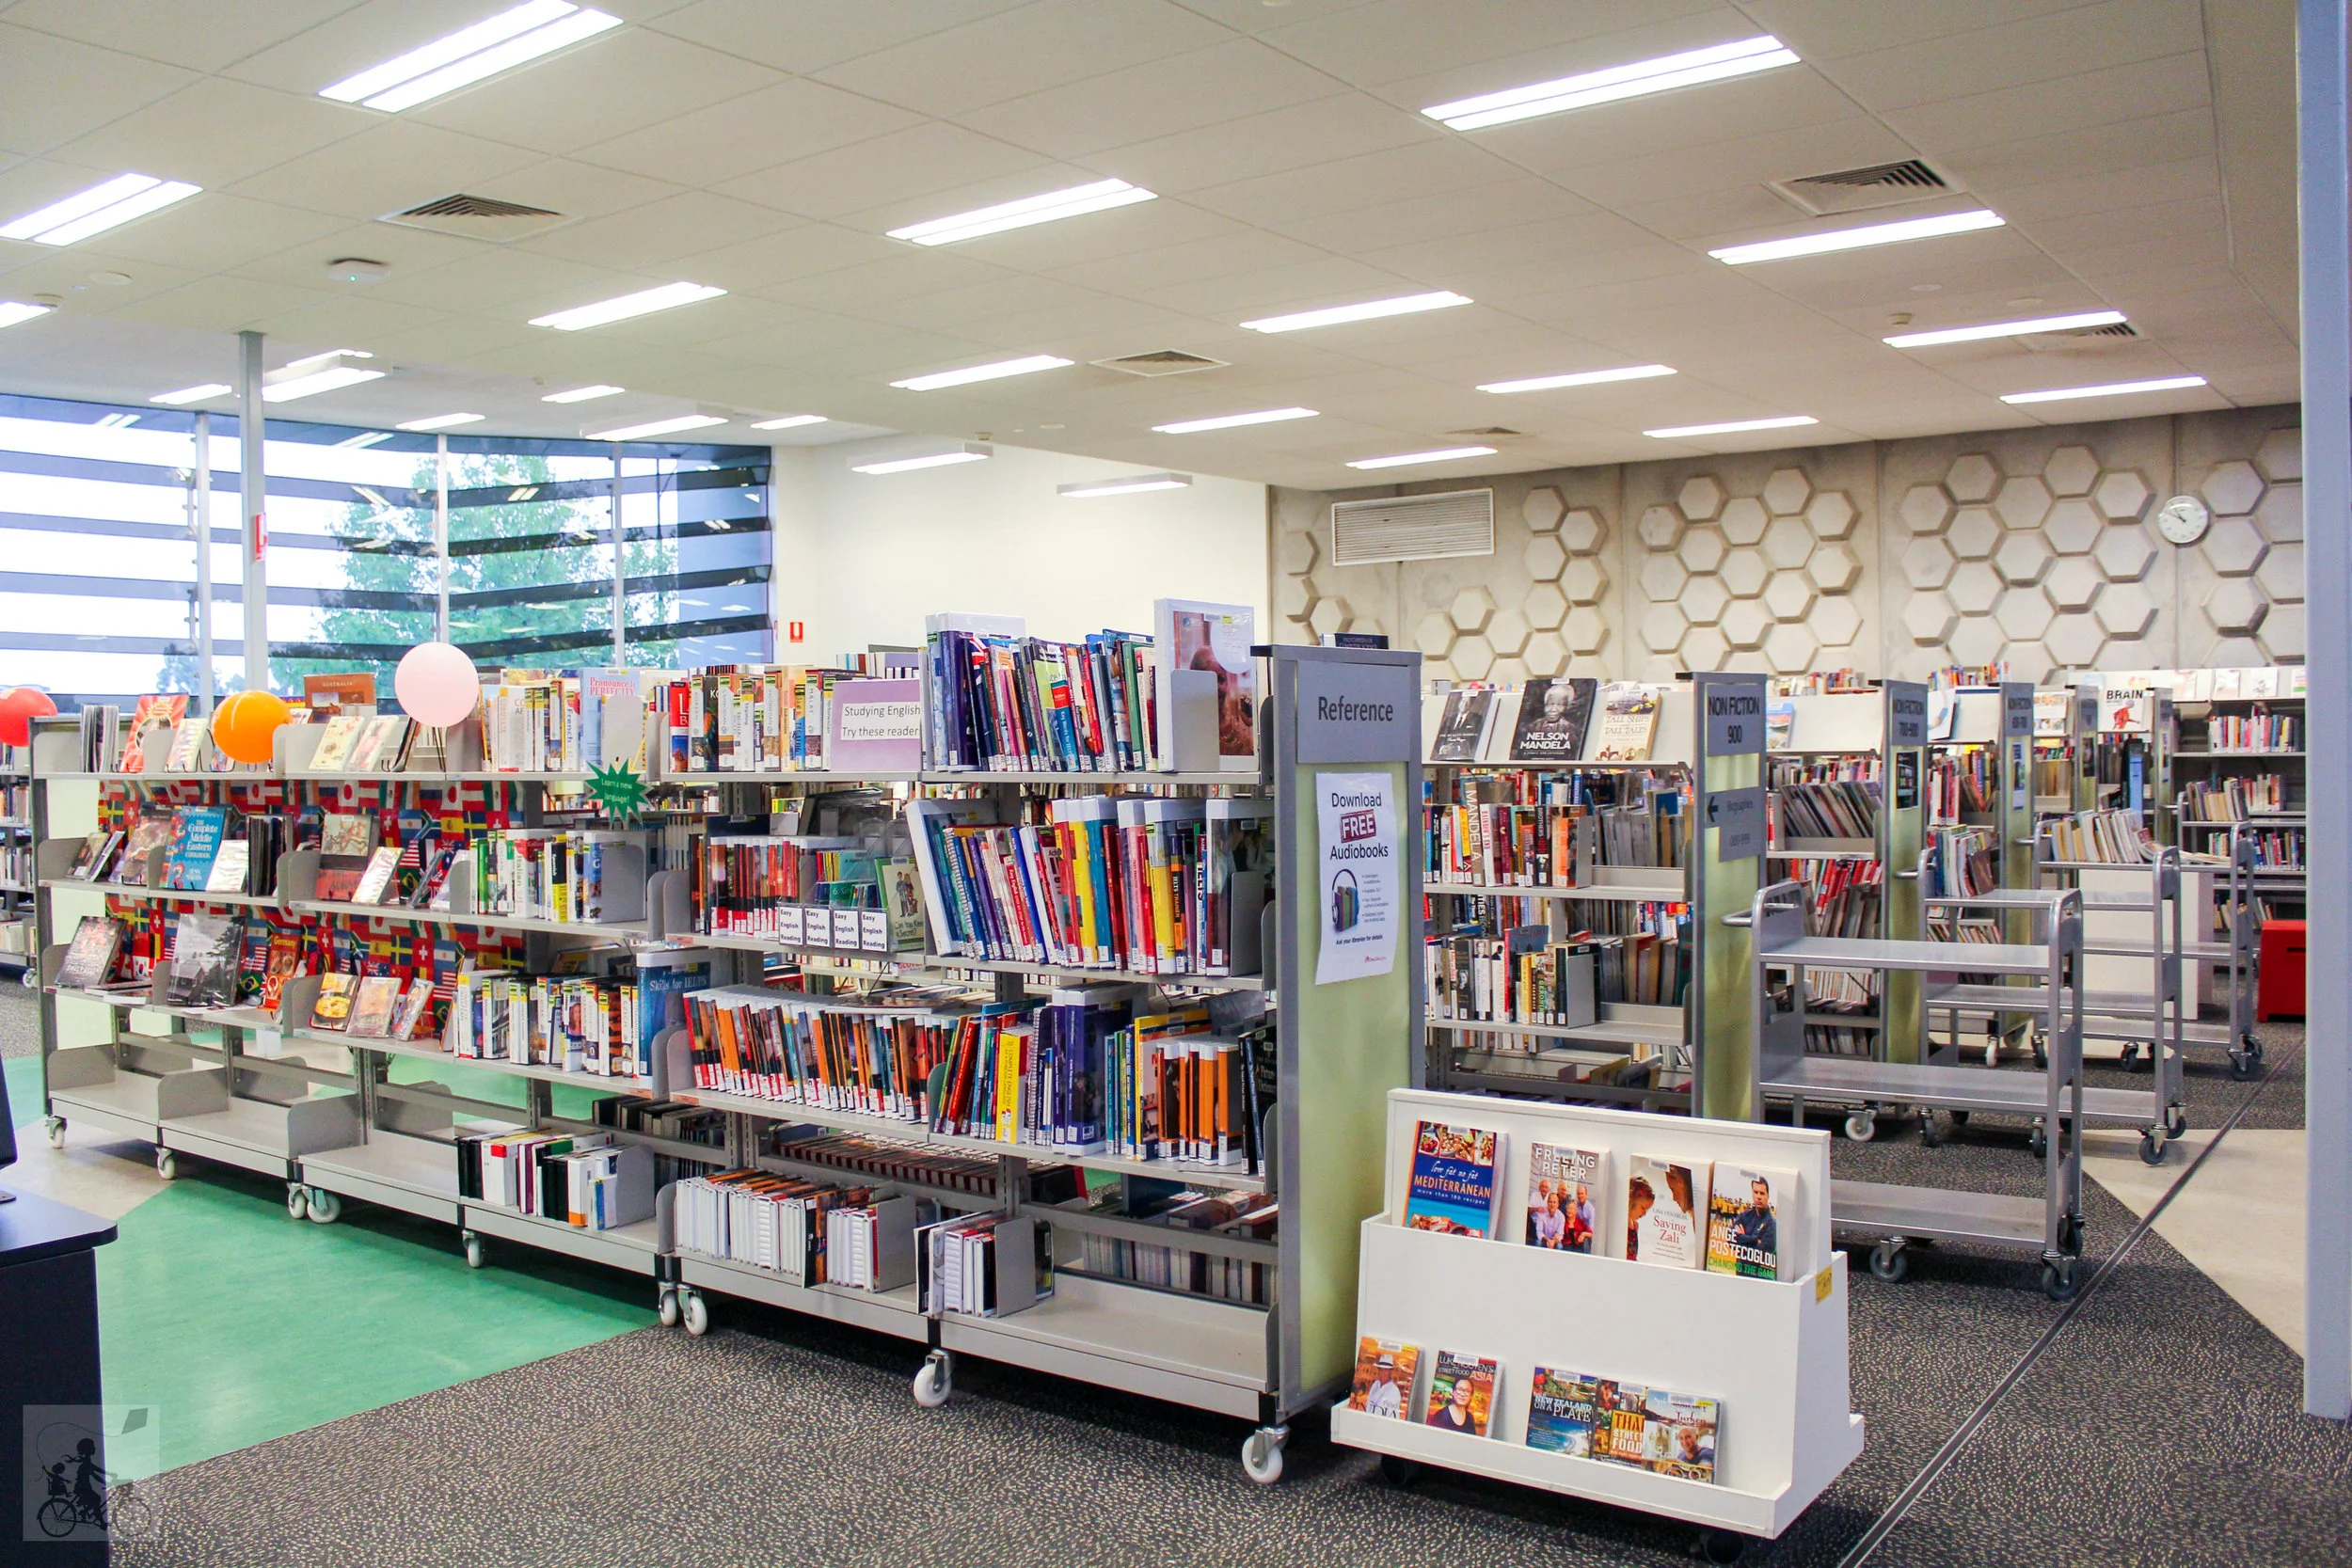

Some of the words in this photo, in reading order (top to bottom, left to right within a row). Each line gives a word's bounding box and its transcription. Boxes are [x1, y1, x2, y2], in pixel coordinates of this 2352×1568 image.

[2106, 689, 2143, 700] BRAIN
[845, 705, 885, 719] Studying
[887, 705, 921, 720] English
[1318, 695, 1393, 721] Reference
[1708, 696, 1727, 716] NON
[1729, 696, 1760, 716] FICTION
[842, 727, 856, 738] Try
[859, 727, 884, 736] these
[1526, 732, 1569, 741] NELSON
[1727, 725, 1742, 744] 900
[1519, 740, 1571, 750] MANDELA
[1331, 792, 1382, 807] Download
[188, 823, 218, 833] Complete
[1342, 814, 1375, 839] FREE
[1466, 789, 1483, 862] MANDELA
[1537, 807, 1547, 836] BROTHERS
[190, 832, 213, 843] Middle
[1330, 843, 1389, 860] Audiobooks
[806, 911, 819, 919] Easy
[834, 912, 847, 921] Easy
[863, 914, 876, 923] Easy
[781, 934, 801, 943] Reading
[807, 936, 829, 944] Reading
[835, 938, 858, 946] Reading
[863, 941, 885, 949] Reading
[649, 977, 669, 990] Skills
[672, 978, 682, 990] for
[684, 973, 707, 989] IELTS
[1430, 1160, 1444, 1174] low
[1445, 1164, 1455, 1178] fat
[1457, 1170, 1467, 1180] no
[1467, 1168, 1479, 1182] fat
[1542, 1163, 1587, 1180] PETER
[1414, 1174, 1491, 1198] MEDITERRANEAN
[1463, 1196, 1486, 1205] recipes
[1653, 1215, 1687, 1236] Saving
[1660, 1229, 1679, 1243] Zali
[1710, 1226, 1738, 1243] ANGE
[1708, 1240, 1776, 1269] POSTECOGLOU
[1708, 1257, 1742, 1273] CHANGING
[1743, 1262, 1756, 1276] THE
[1757, 1266, 1776, 1279] GAME
[1470, 1371, 1493, 1383] ASIA
[1534, 1395, 1552, 1406] NEW
[1553, 1399, 1592, 1412] ZEALAND
[1534, 1402, 1546, 1410] ON
[1546, 1403, 1552, 1412] A
[1553, 1405, 1591, 1423] PLATE
[1614, 1413, 1645, 1433] THAI
[1613, 1429, 1645, 1442] STREET
[1612, 1438, 1643, 1454] FOOD
